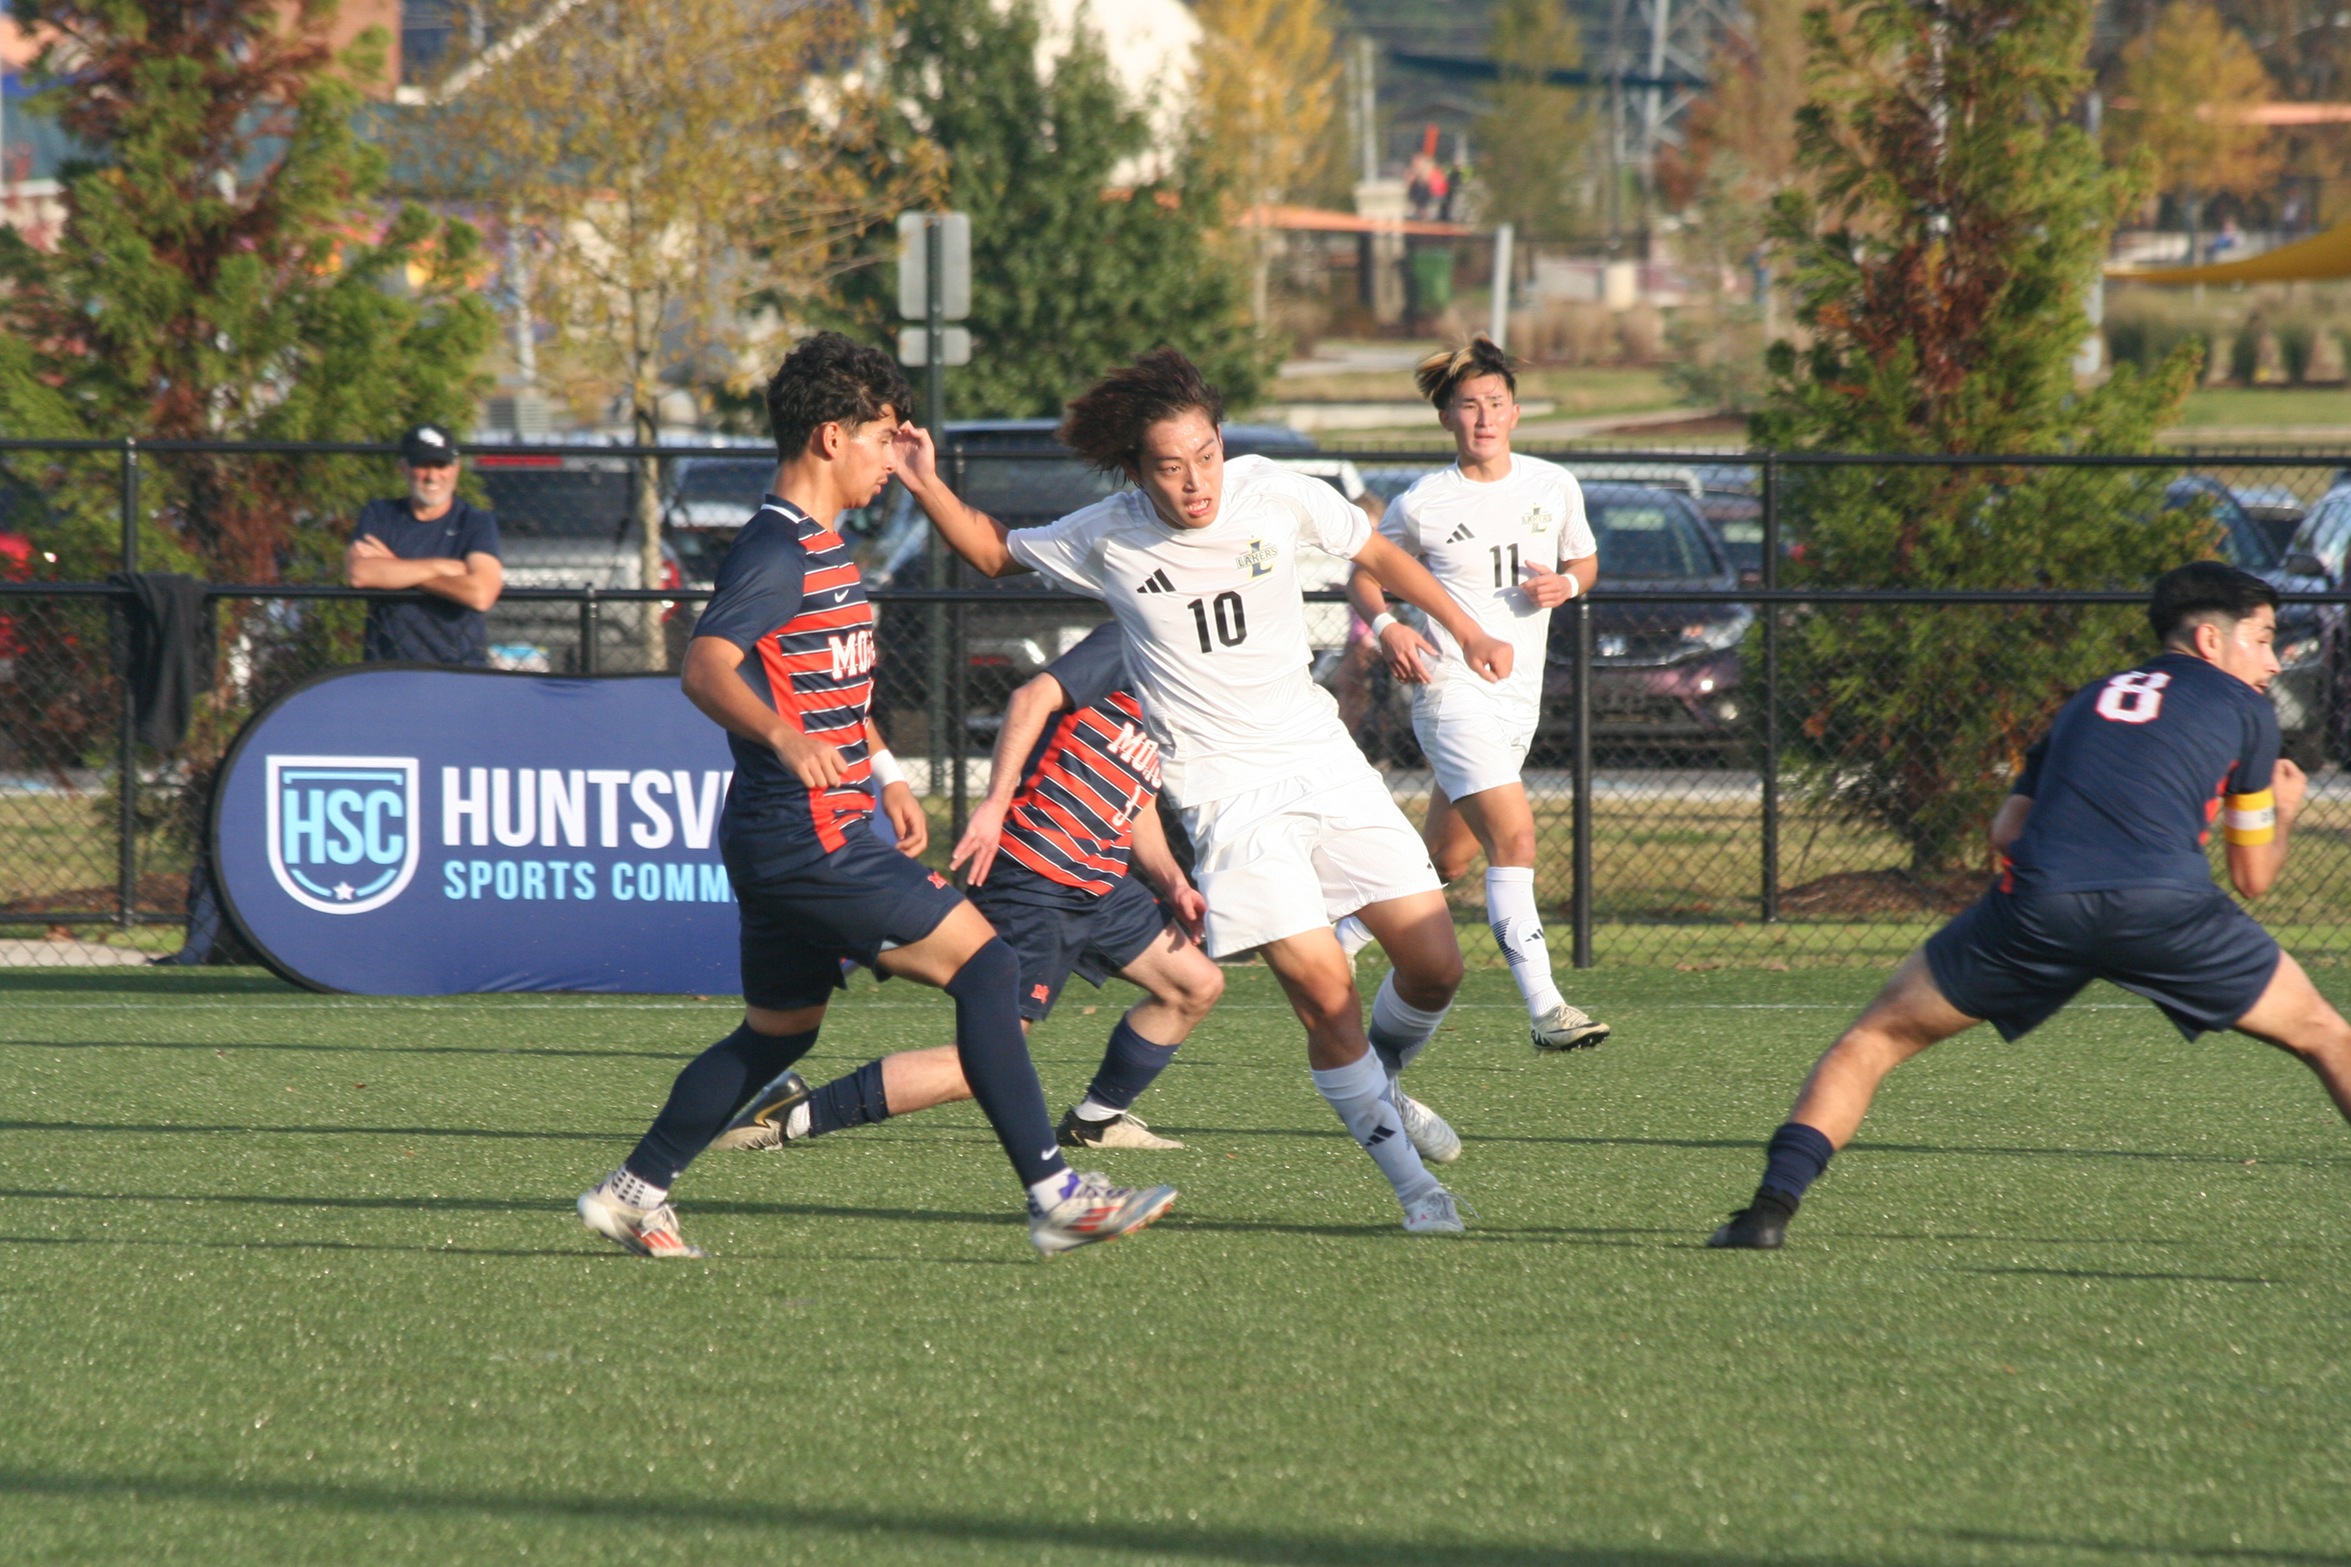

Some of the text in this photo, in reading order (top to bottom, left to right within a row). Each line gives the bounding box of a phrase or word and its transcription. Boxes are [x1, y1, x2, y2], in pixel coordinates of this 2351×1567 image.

[1236, 546, 1278, 568] LAKERS
[1489, 543, 1519, 588] 11
[1187, 590, 1247, 654] 10
[2094, 671, 2172, 725] 8
[283, 788, 404, 865] HSC
[444, 860, 739, 903] SPORTS COMM
